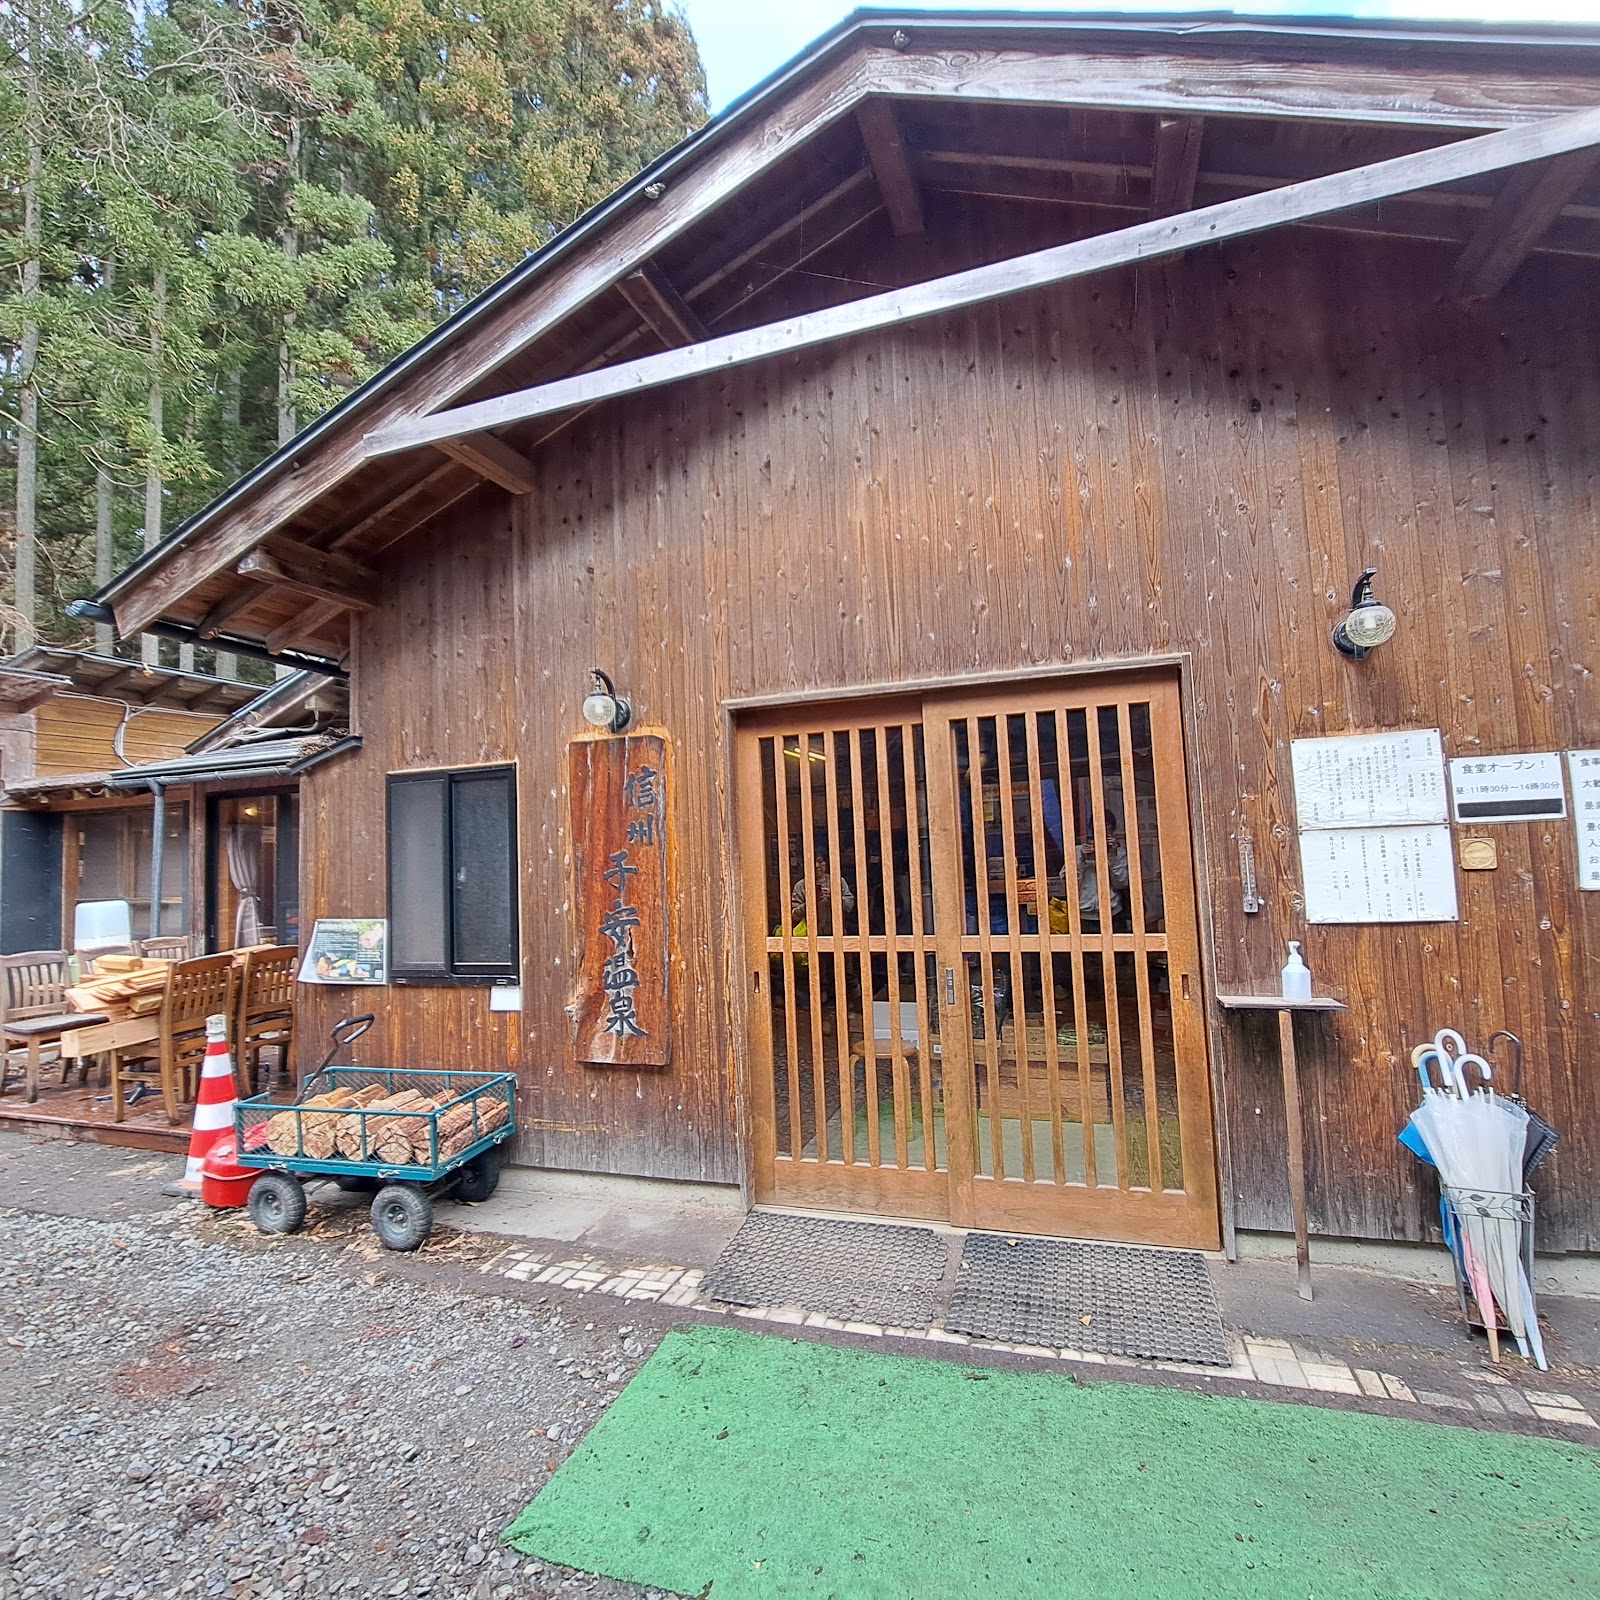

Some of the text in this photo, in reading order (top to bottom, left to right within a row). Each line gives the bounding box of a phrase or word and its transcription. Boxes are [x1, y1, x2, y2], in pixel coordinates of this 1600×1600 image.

[624, 764, 657, 846] 信州
[1462, 760, 1545, 775] 食堂オープン！
[598, 850, 650, 1037] 子安温泉
